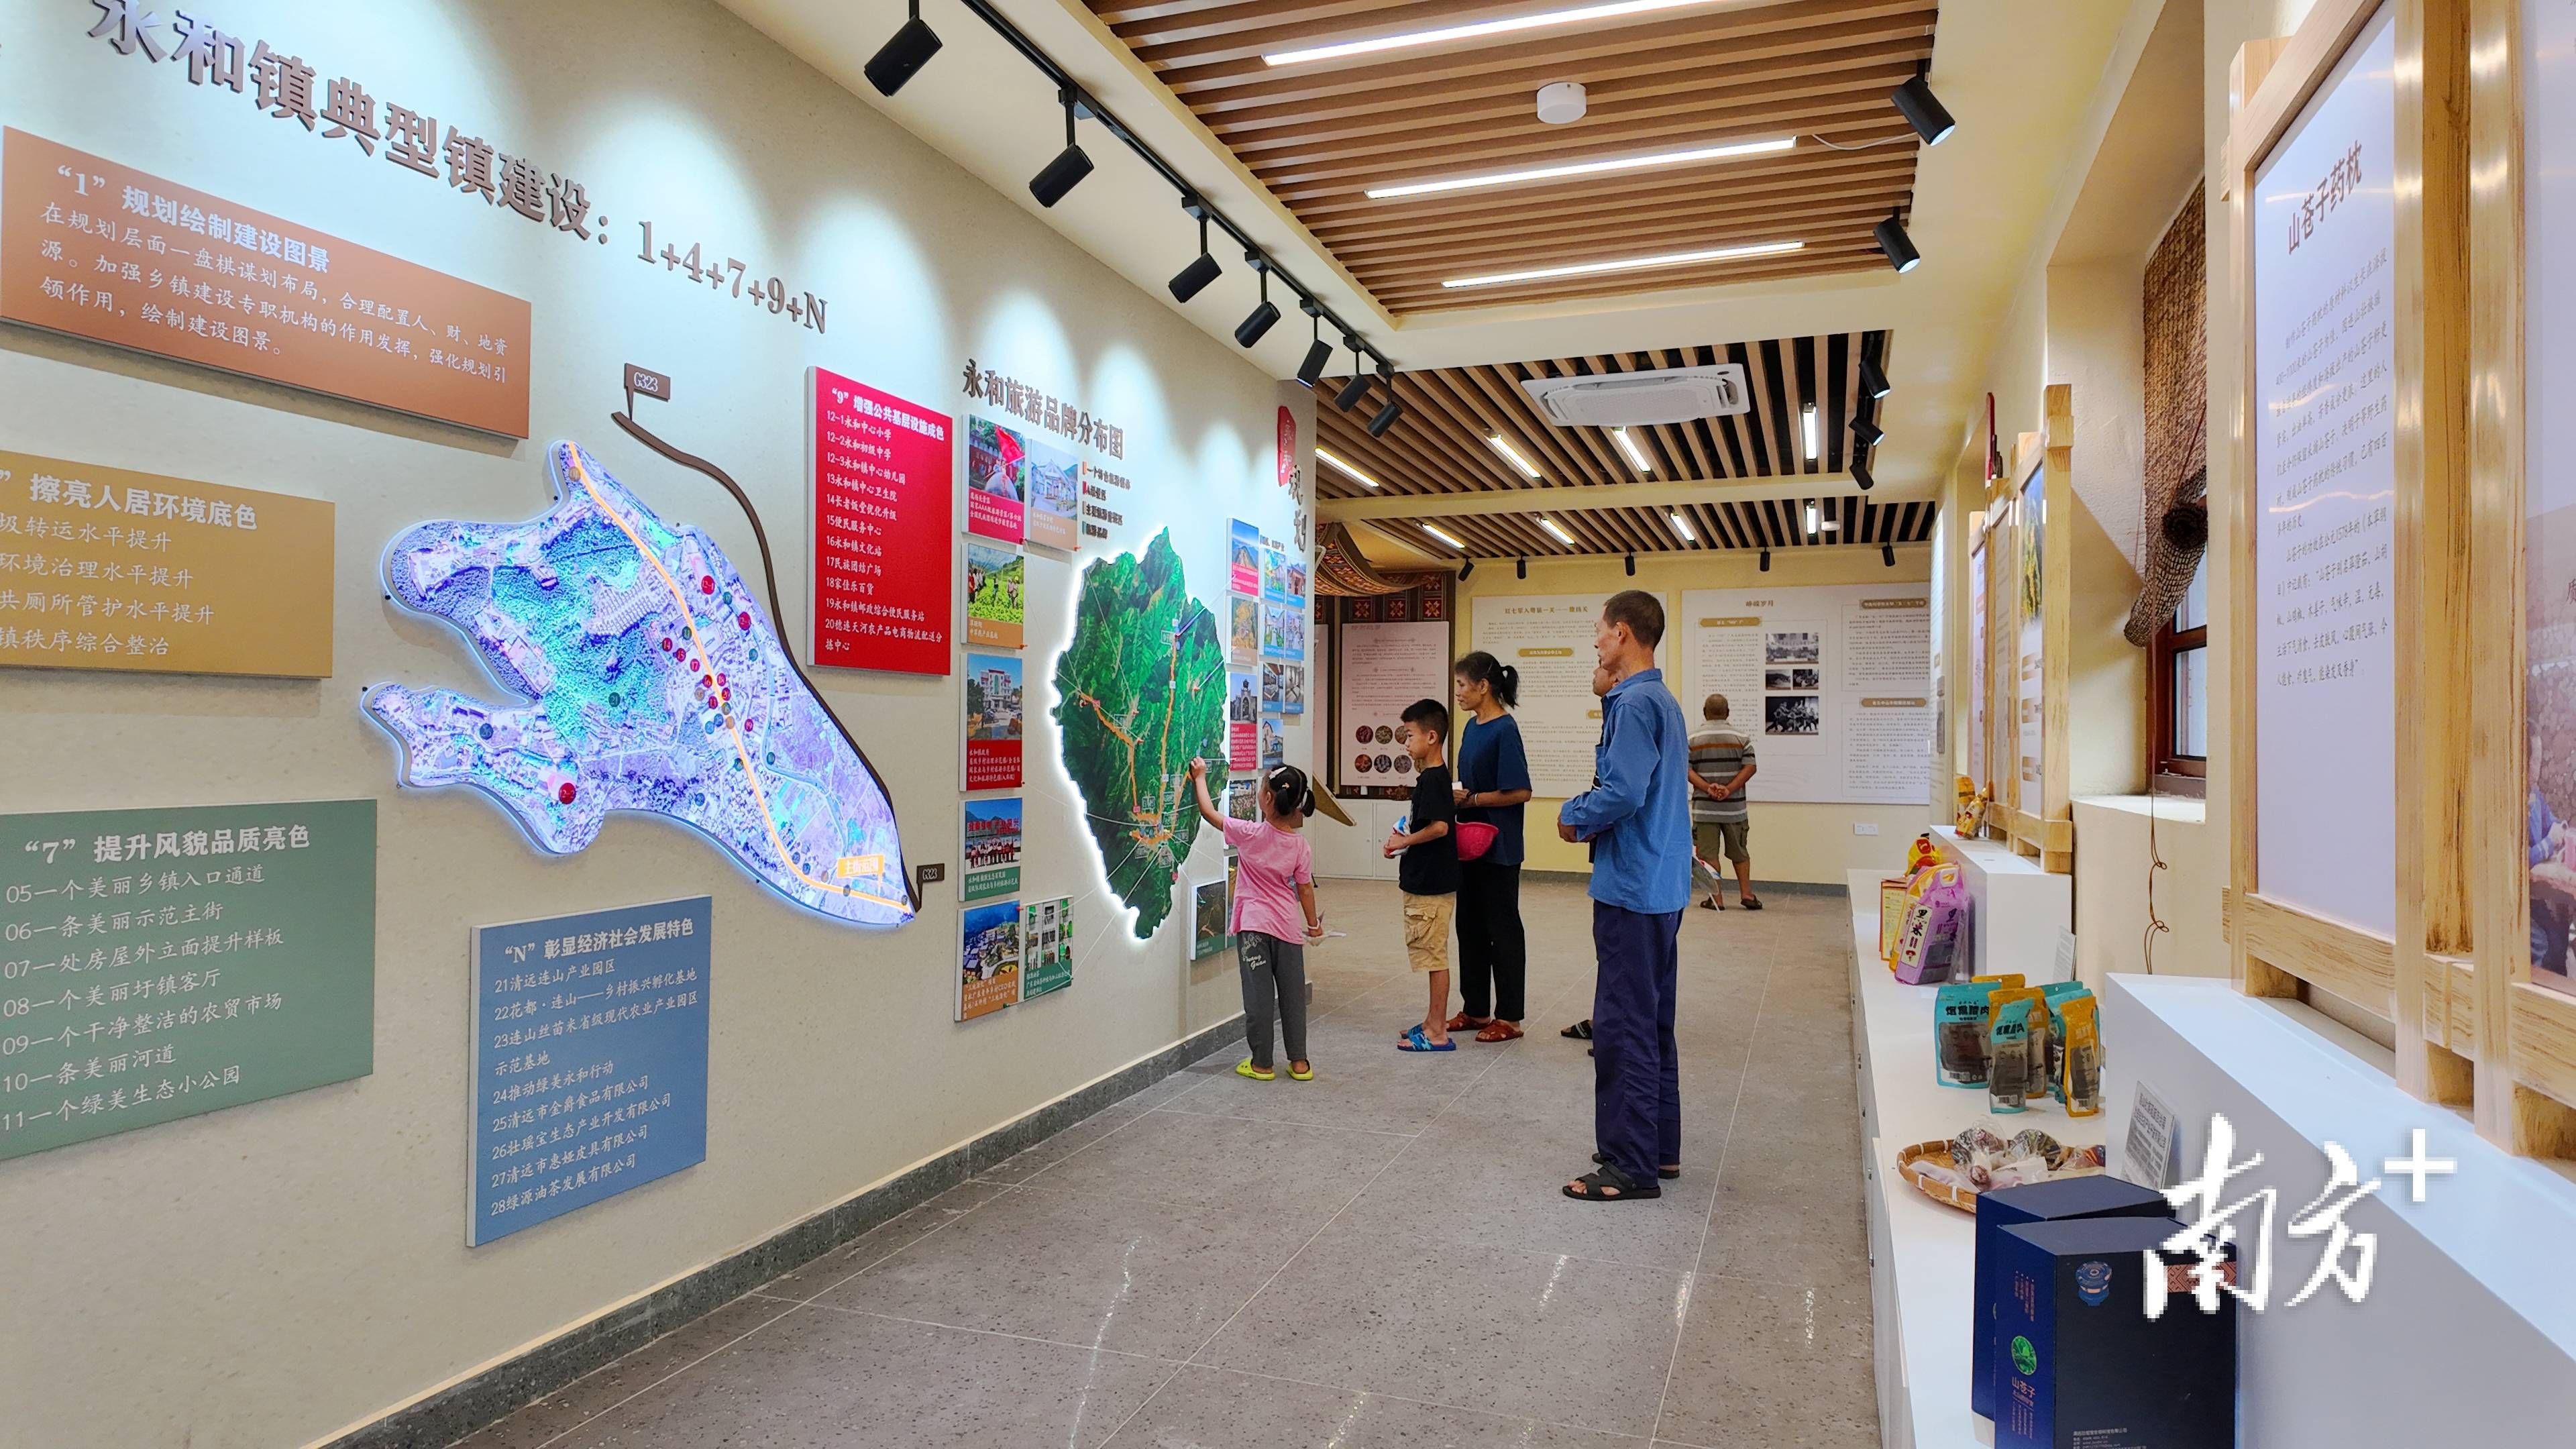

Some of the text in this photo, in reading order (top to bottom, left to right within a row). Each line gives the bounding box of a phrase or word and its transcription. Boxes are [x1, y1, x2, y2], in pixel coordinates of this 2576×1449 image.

[2288, 140, 2363, 255] 山苍子药枕
[40, 203, 508, 356] 在规划层面一盘棋谋划布局，合理配置人、财、地资
[40, 239, 506, 383] 源。加强乡镇建设专职机构的作用发挥，强化规划引
[40, 277, 282, 356] 领作用，绘制建设图景。
[633, 372, 658, 392] G323
[963, 358, 1124, 460] 永和旅游品牌分布图
[826, 515, 882, 536] 15便民服务中心
[826, 535, 882, 557] 16永和镇文化站
[826, 556, 881, 577] 17民族团结广场
[6, 864, 265, 904] 05一个美丽乡镇入口通道
[5, 901, 223, 941] 06一条美丽示范主街
[5, 928, 284, 979] 07一处房屋外立面提升样板
[495, 959, 615, 994] 21清远连山产业园区
[3, 968, 221, 1018] 08一个美丽圩镇客厅
[2, 994, 282, 1056] 09一个干净整洁的农贸市场
[494, 991, 698, 1049] 23连山丝苗米省级现代农业产业园区
[3, 1044, 176, 1094] 10一条美丽河道
[493, 1060, 614, 1105] 24推动绿美永和行动
[495, 1051, 550, 1077] 示范基地
[1, 1065, 241, 1131] 11一个绿美生态小公园
[492, 1093, 672, 1161] 26壮瑶宝生态产业开发有限公司
[490, 1153, 635, 1216] 28绿源油茶发展有限公司
[2012, 1376, 2036, 1398] 山苍子
